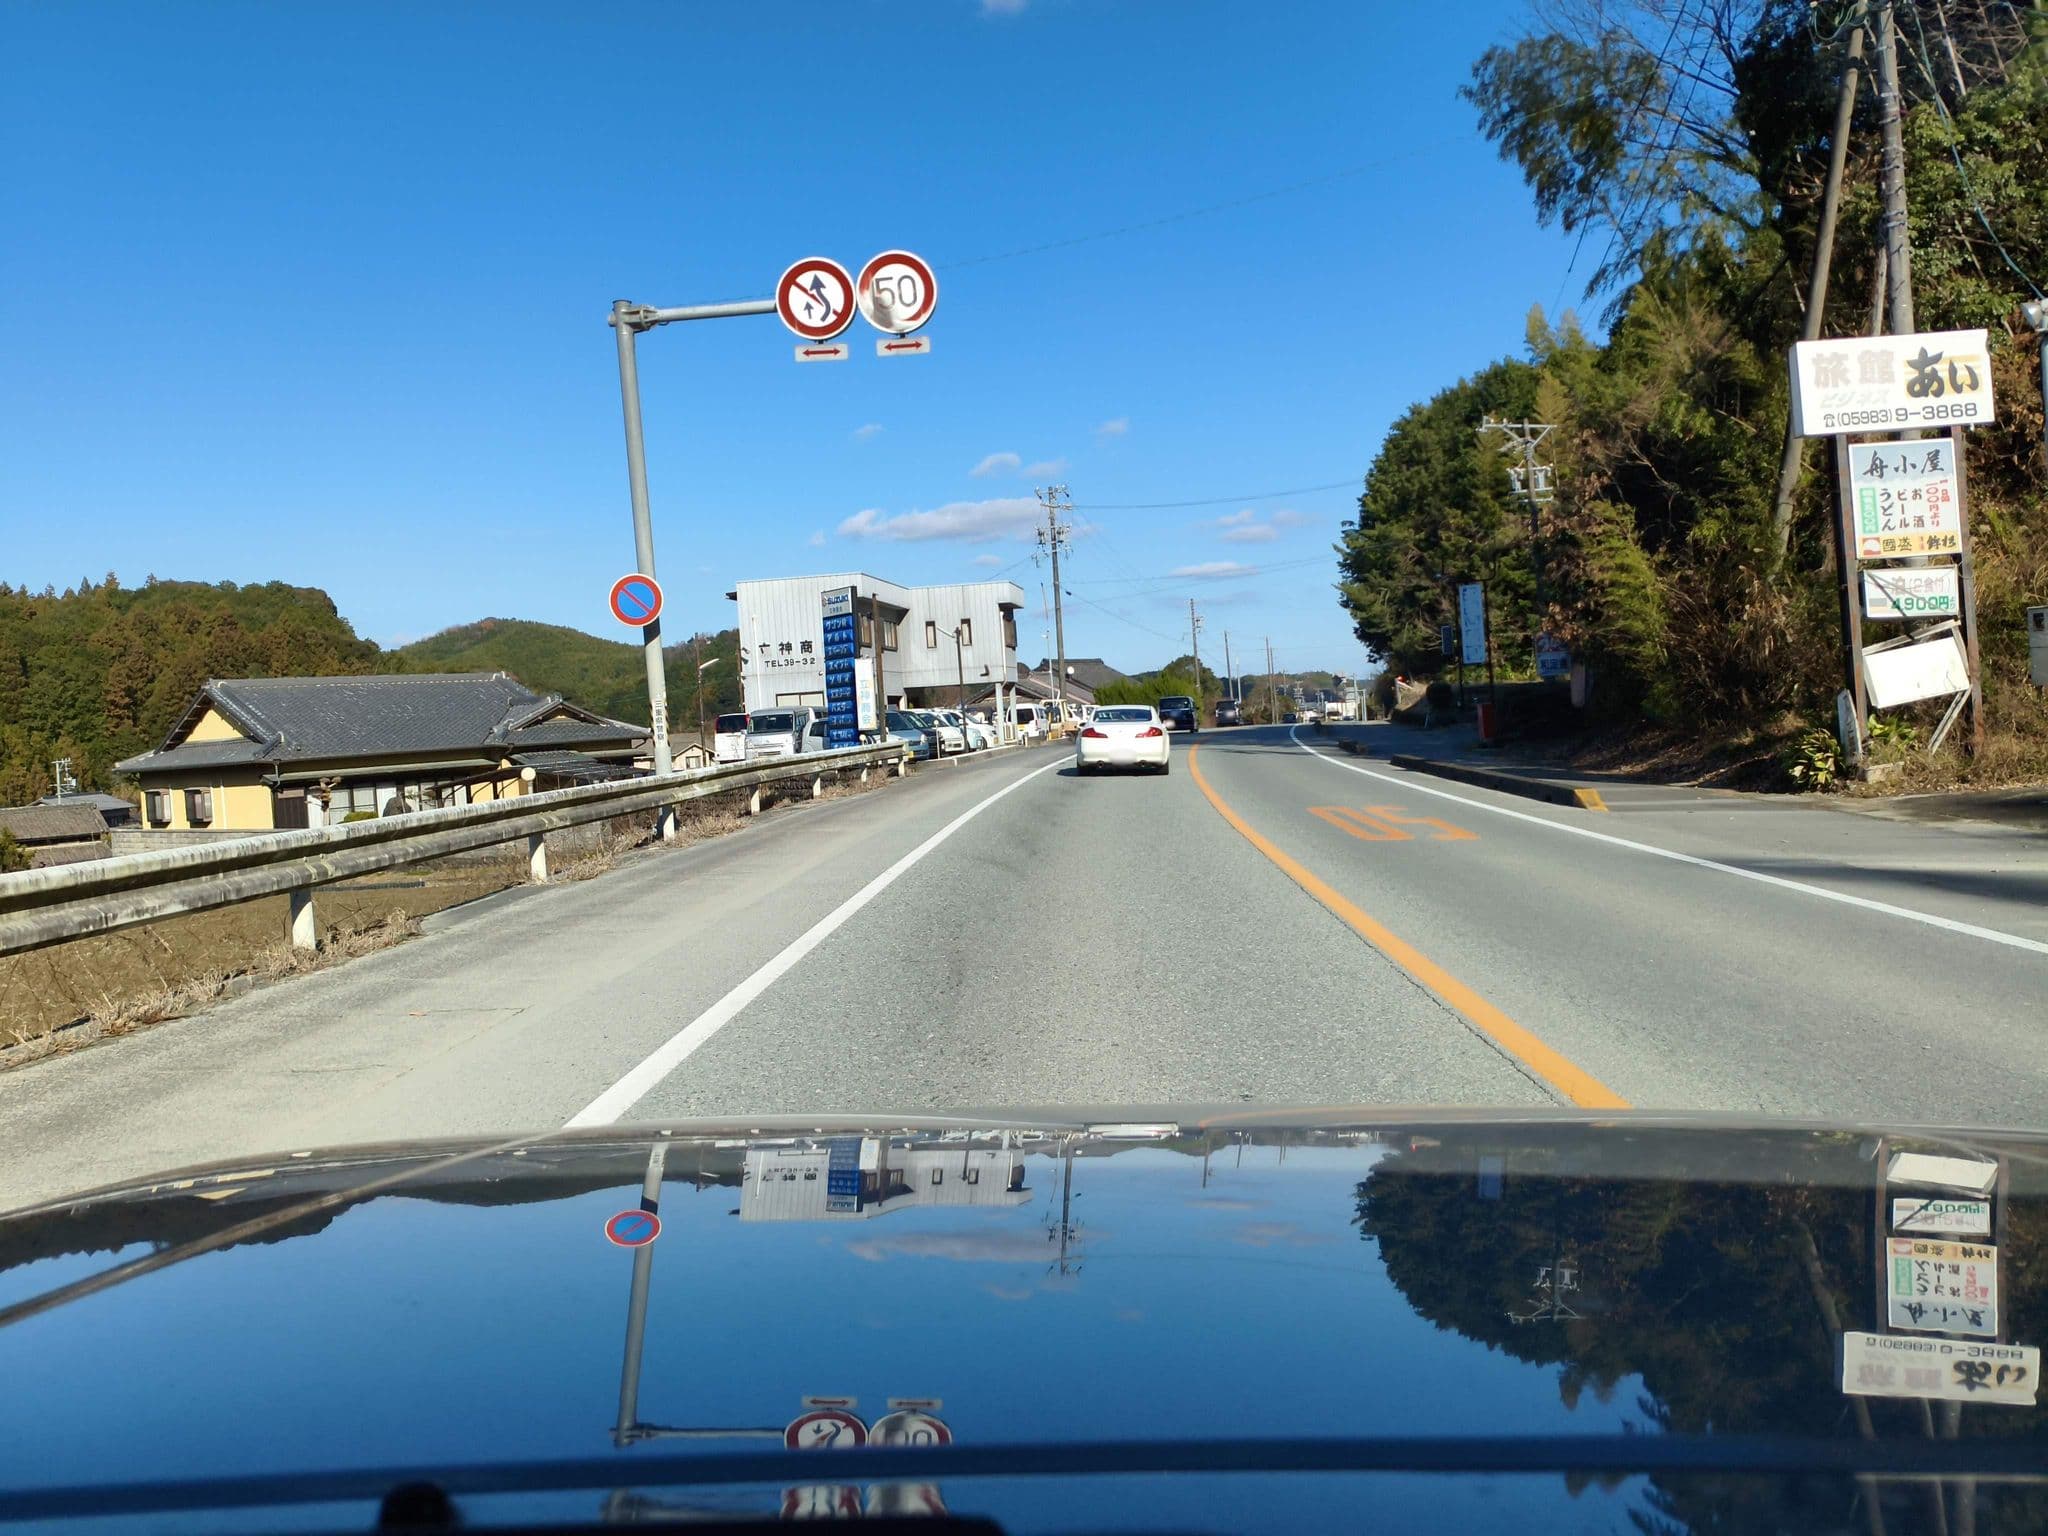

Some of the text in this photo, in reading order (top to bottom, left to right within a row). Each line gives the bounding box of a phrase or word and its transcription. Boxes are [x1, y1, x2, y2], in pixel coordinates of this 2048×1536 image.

[874, 275, 917, 310] 50
[1906, 346, 1979, 398] あい
[1863, 449, 1945, 479] 舟小屋
[1897, 489, 1910, 528] ビール
